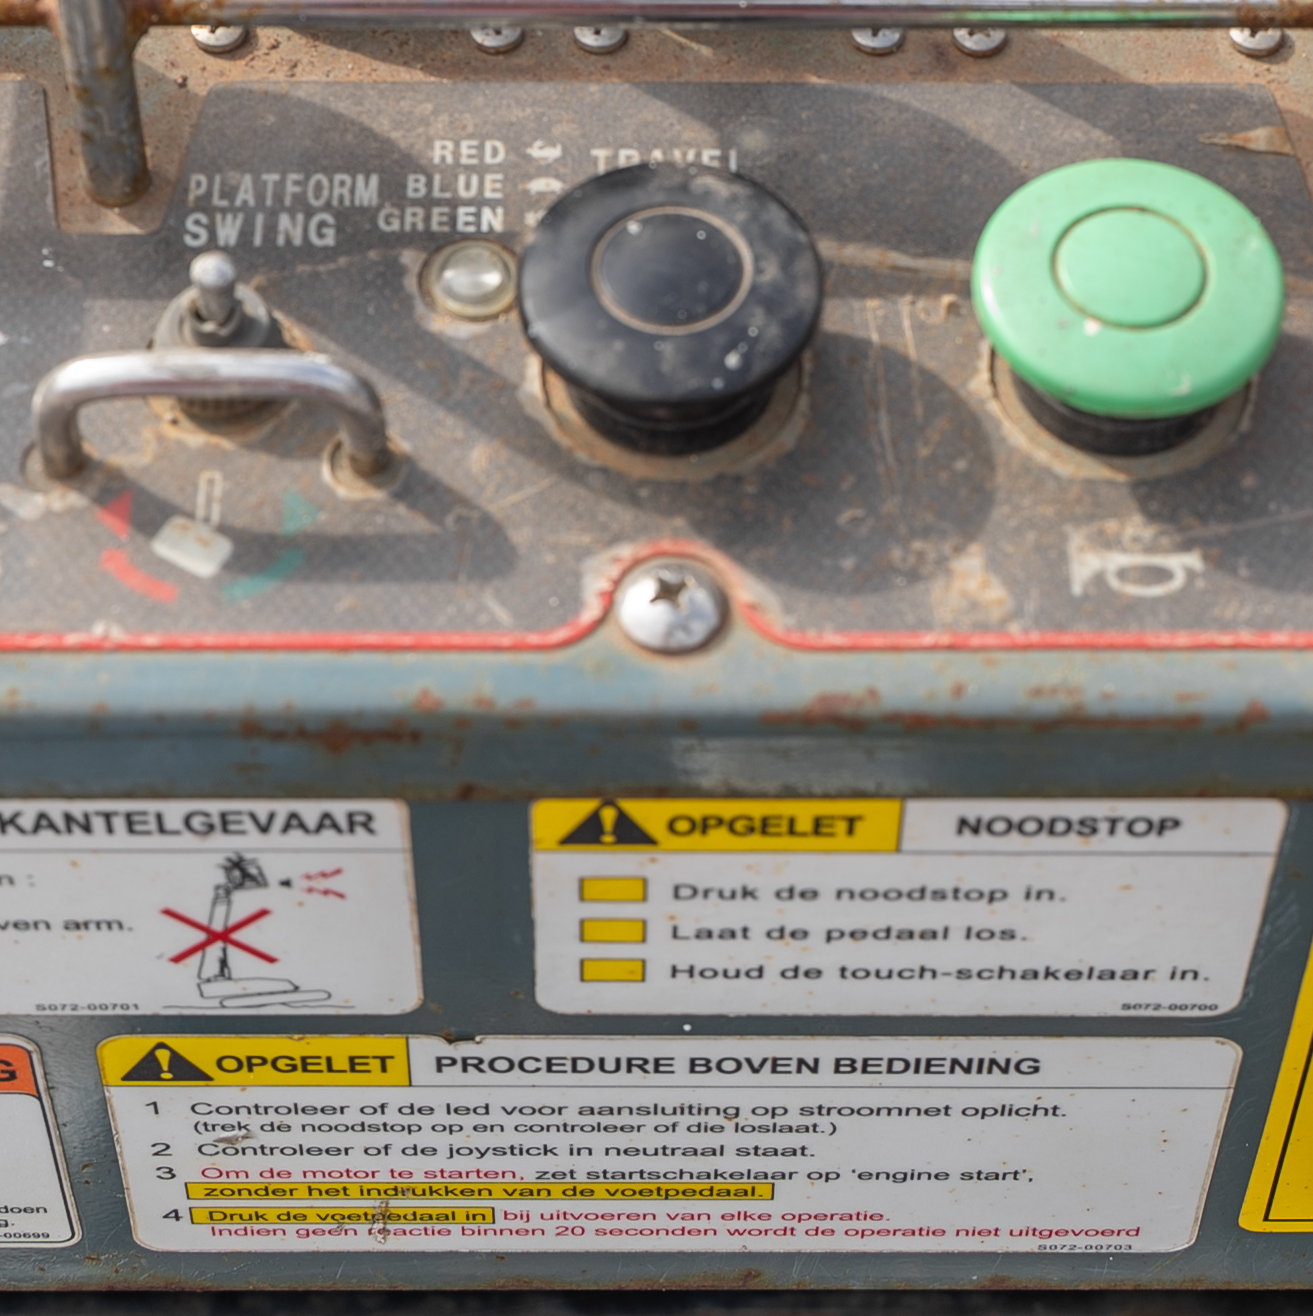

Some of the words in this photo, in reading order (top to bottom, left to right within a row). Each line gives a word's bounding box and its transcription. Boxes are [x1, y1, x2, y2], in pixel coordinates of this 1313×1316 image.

[431, 139, 507, 165] RED
[186, 172, 380, 208] PLATFORM
[405, 172, 505, 199] BLUE
[182, 212, 338, 248] SWING
[376, 206, 505, 233] GREEN
[666, 814, 864, 839] OPGELET
[955, 815, 1182, 839] NOODSTOP
[672, 883, 759, 901] Druk
[773, 884, 820, 902] de
[835, 885, 1009, 906] noodstop
[1023, 886, 1065, 902] in.
[62, 919, 133, 932] arm.
[671, 924, 750, 941] Laat
[765, 924, 810, 941] de
[824, 925, 950, 945] pedaal
[964, 925, 1027, 942] los.
[670, 964, 765, 980] Houd
[779, 964, 824, 980] de
[838, 964, 1156, 982] touch-schakelaar
[1169, 965, 1209, 982] in.
[215, 1055, 395, 1075] OPGELET
[435, 1055, 676, 1075] PROCEDURE
[688, 1056, 820, 1075] BOVEN
[833, 1057, 1041, 1076] BEDIENING
[145, 1101, 159, 1115] 1
[190, 1102, 351, 1116] Controleer
[359, 1102, 389, 1116] of
[397, 1102, 435, 1116] de
[445, 1102, 490, 1116] led
[500, 1105, 569, 1116] voor
[577, 1102, 740, 1120] aansluiting
[751, 1106, 789, 1121] op
[798, 1103, 953, 1118] stroomnet
[960, 1103, 1067, 1121] oplicht.
[151, 1142, 173, 1157] 2
[197, 1143, 355, 1157] Controleer
[363, 1143, 393, 1157] of
[400, 1143, 438, 1157] de
[446, 1143, 559, 1160] joystick
[569, 1143, 593, 1157] in
[604, 1144, 725, 1157] neutraal
[735, 1144, 815, 1158] staat.
[156, 1166, 176, 1180] 3
[201, 1167, 251, 1180] Om
[260, 1167, 293, 1180] de
[302, 1168, 382, 1180] motor
[389, 1168, 414, 1180] te
[423, 1168, 525, 1182] starten,
[535, 1169, 578, 1181] zet
[585, 1168, 799, 1182] startschakelaar
[806, 1170, 841, 1185] op
[203, 1185, 298, 1198] zonder
[307, 1185, 350, 1198] het
[359, 1185, 493, 1198] indrukken
[502, 1188, 552, 1198] van
[562, 1186, 596, 1198] de
[605, 1186, 764, 1201] voetpedaal.
[162, 1209, 184, 1222] 4
[208, 1210, 269, 1222] Druk
[277, 1210, 308, 1222] de
[466, 1210, 487, 1222] in
[503, 1209, 531, 1224] bij
[539, 1209, 657, 1222] uitvoeren
[665, 1212, 711, 1222] van
[720, 1210, 773, 1222] elke
[780, 1210, 890, 1224] operatie.
